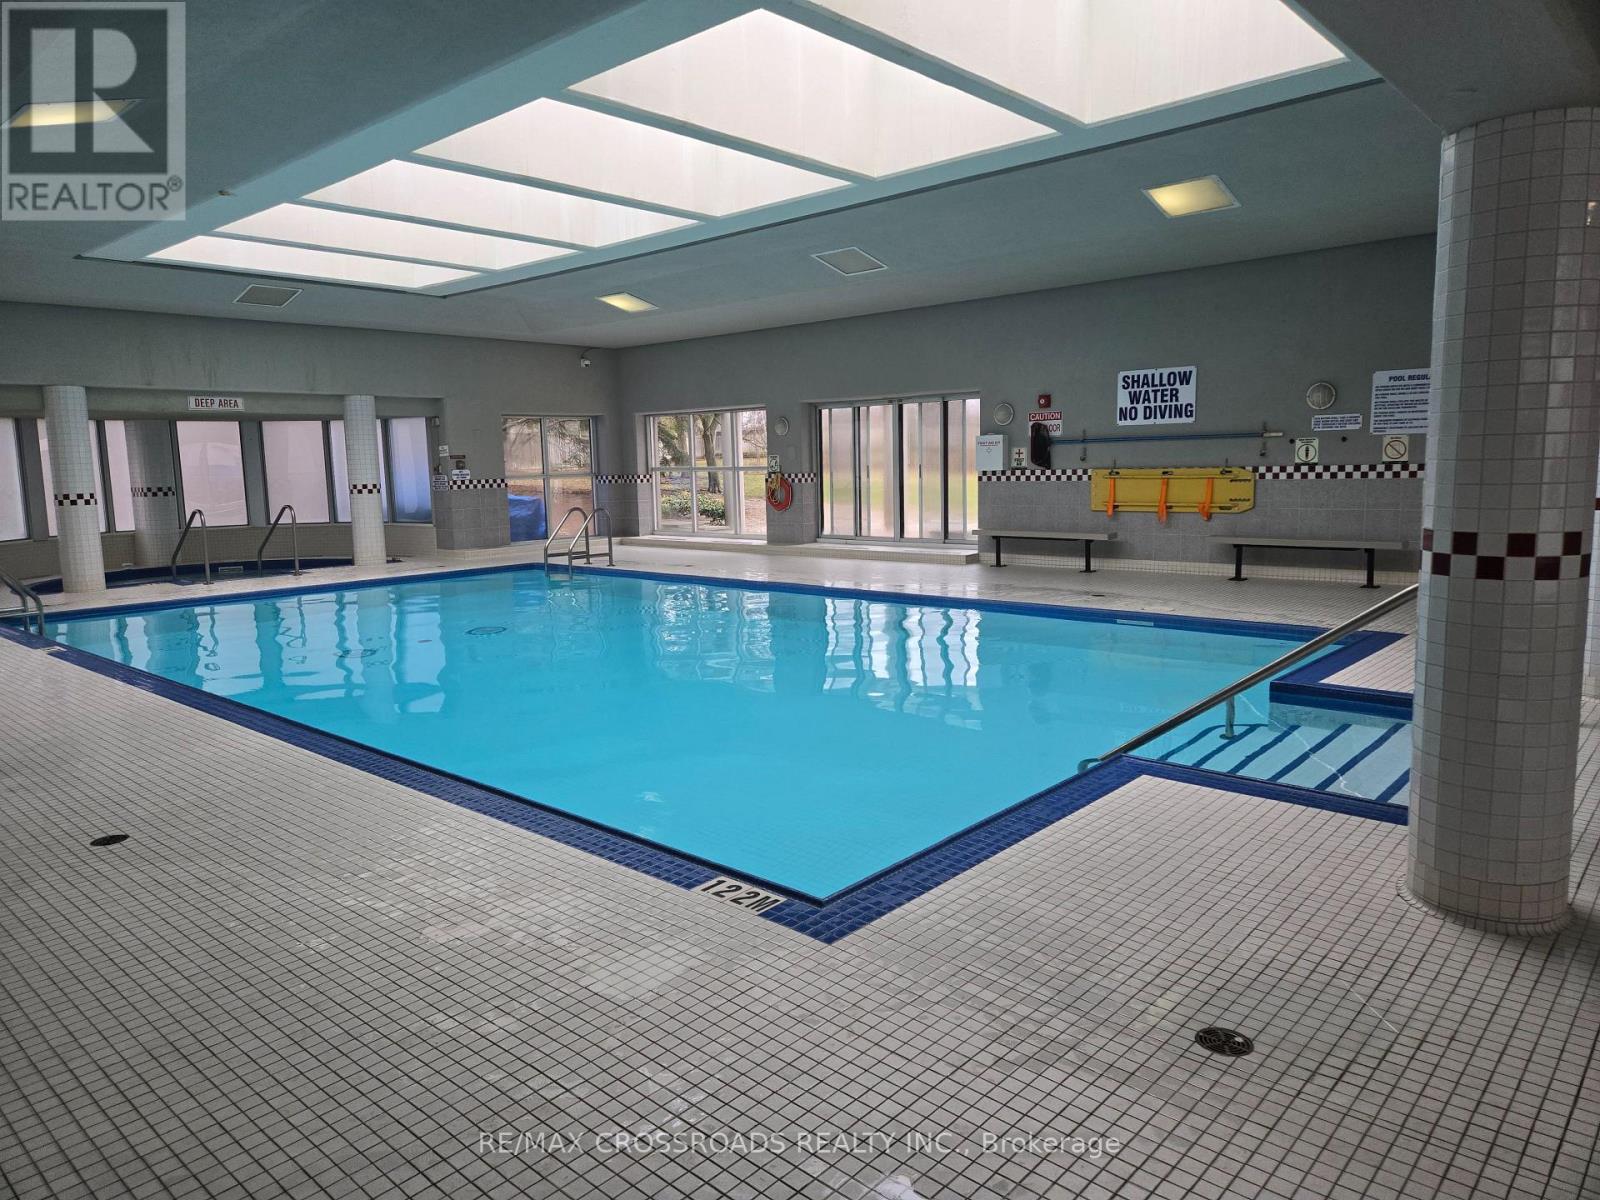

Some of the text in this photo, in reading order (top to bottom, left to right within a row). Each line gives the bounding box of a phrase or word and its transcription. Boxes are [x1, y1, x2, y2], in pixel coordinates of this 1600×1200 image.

[1121, 370, 1193, 390] SHALLOW
[1407, 373, 1431, 381] REGUL
[1128, 387, 1180, 405] WATER
[194, 398, 239, 409] DEEP AREA
[1029, 413, 1061, 421] CAUTION
[1118, 402, 1194, 422] NO DIVING
